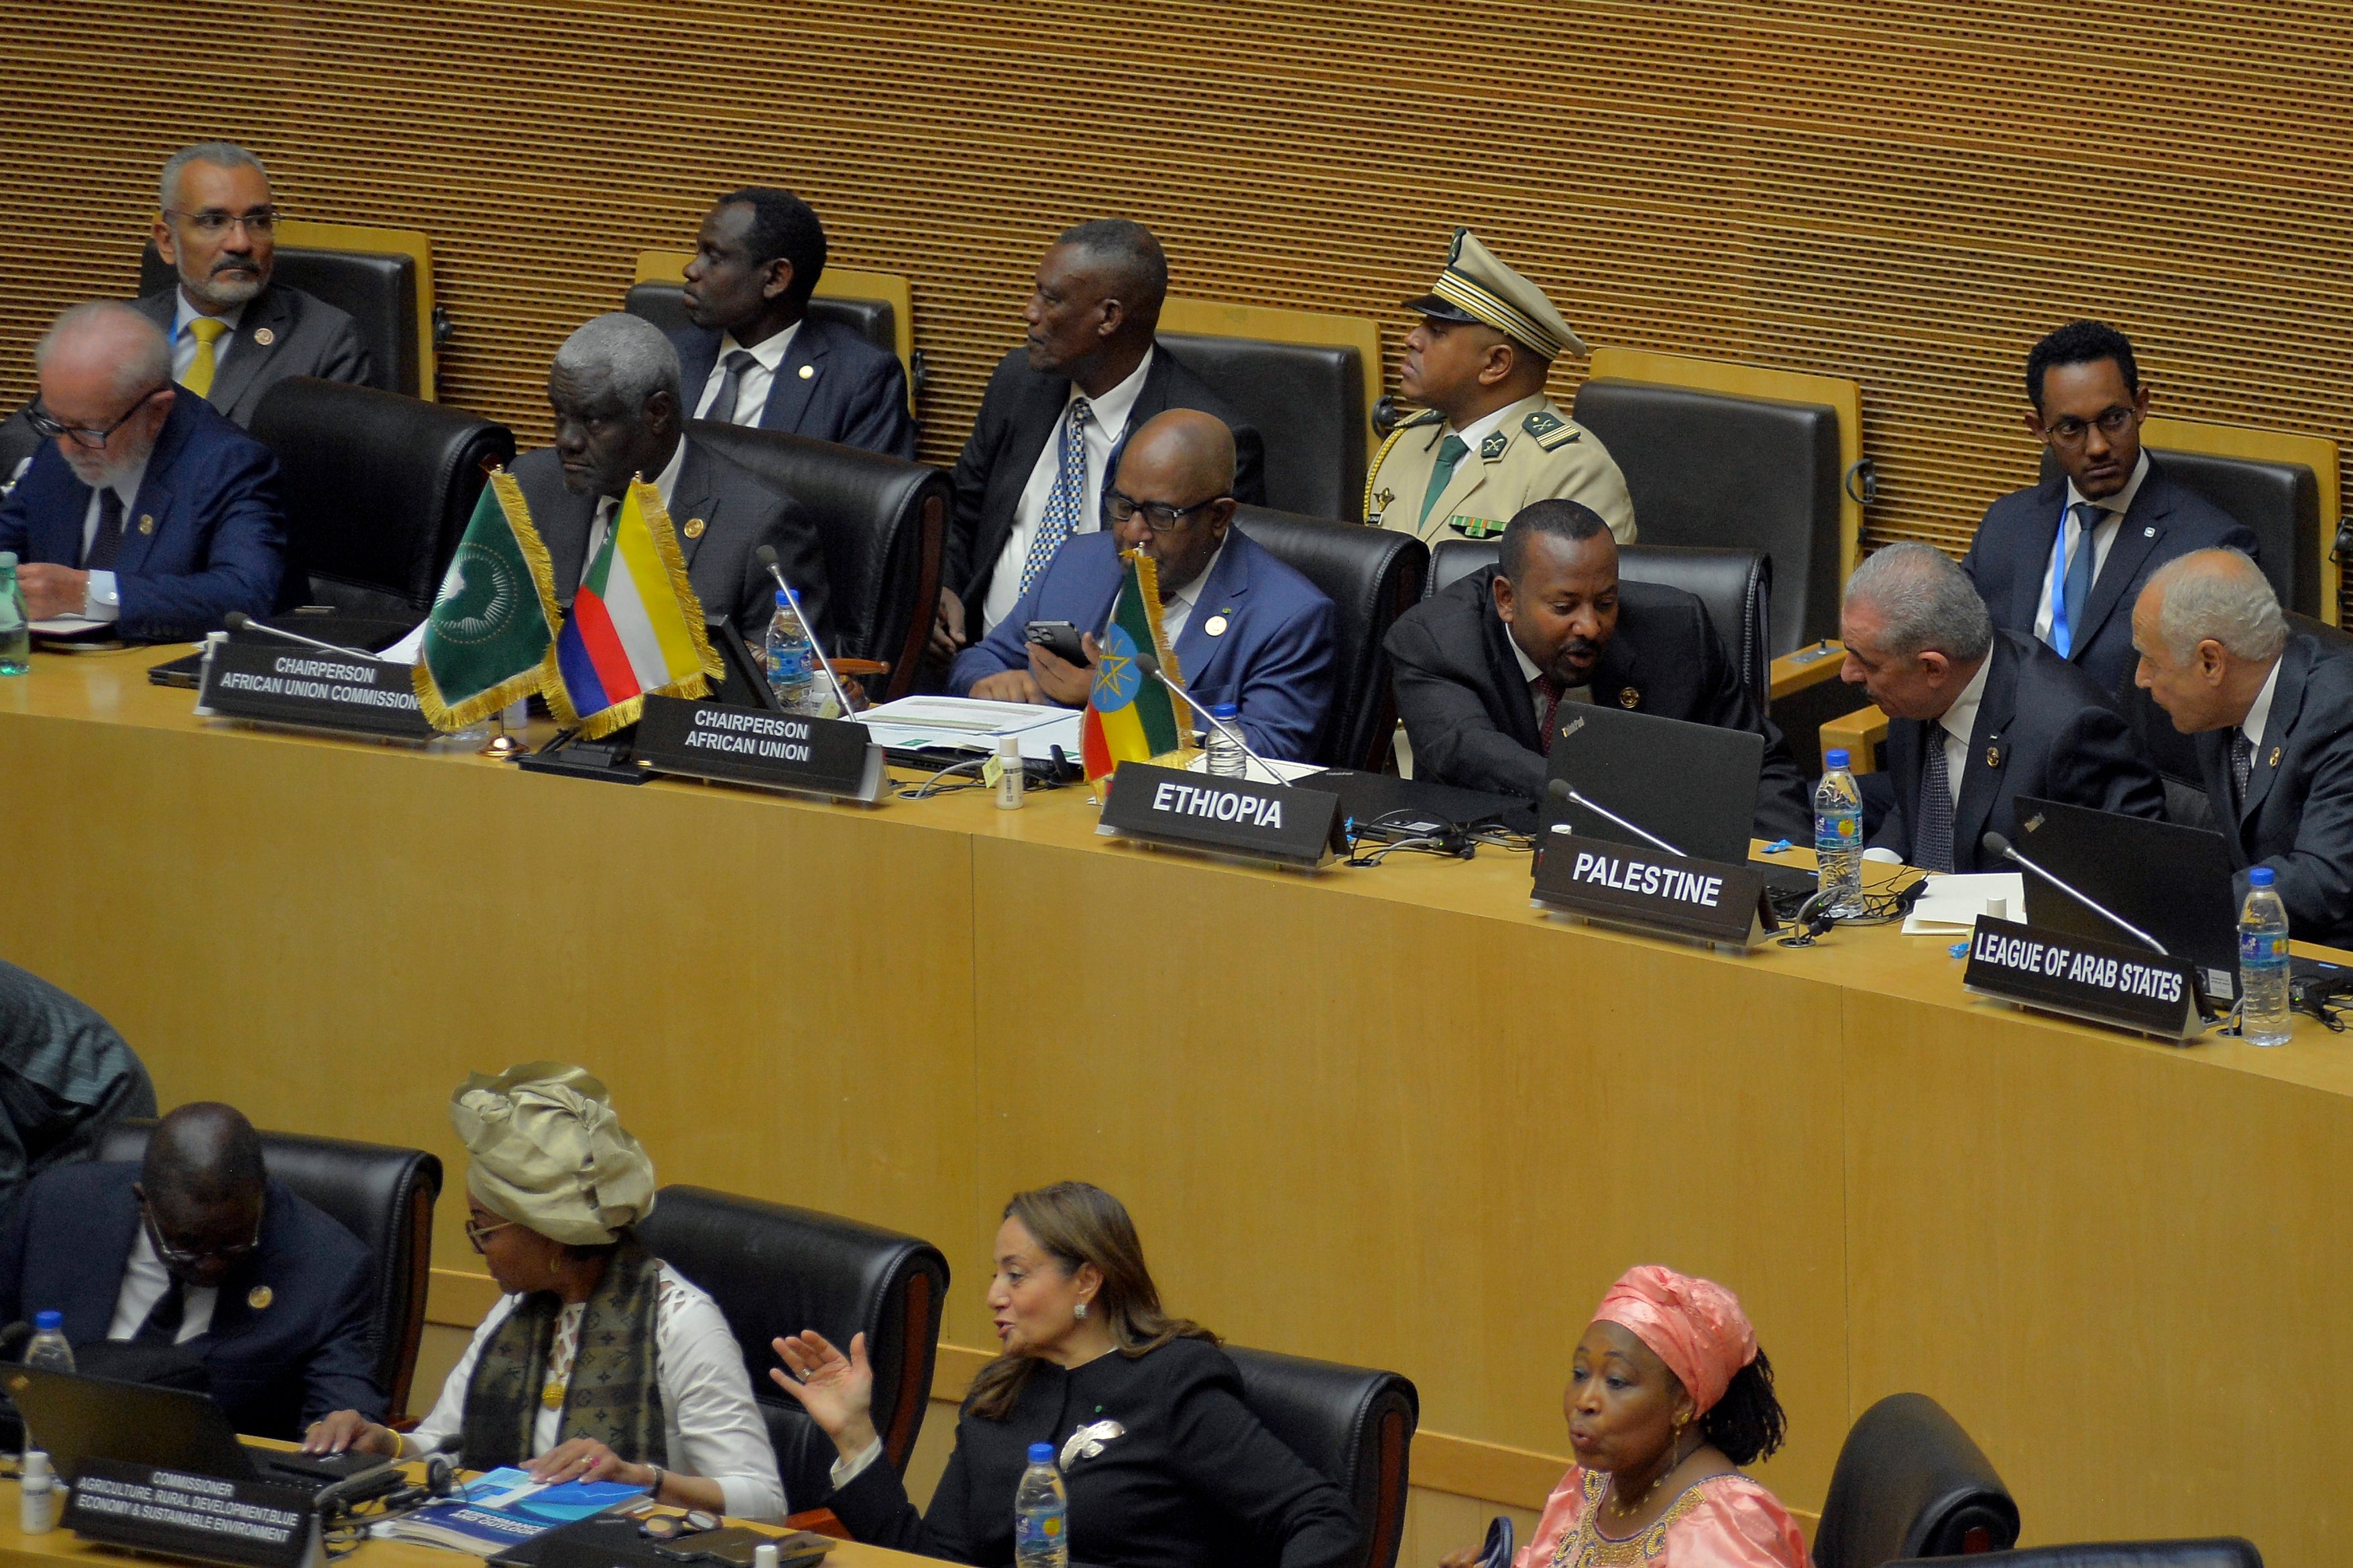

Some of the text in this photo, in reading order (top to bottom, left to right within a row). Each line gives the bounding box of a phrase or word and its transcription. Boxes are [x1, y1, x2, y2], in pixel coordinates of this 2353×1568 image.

[276, 657, 375, 683] CHAIRPERSON
[220, 672, 418, 710] AFRICAN UNION COMMISSION
[695, 709, 809, 739] CHAIRPERSON
[685, 731, 809, 762] AFRICAN UNION
[1153, 782, 1281, 829] ETHIOPIA
[1572, 853, 1723, 907] PALESTINE
[1975, 932, 2044, 972] LEAGUE
[2045, 947, 2070, 977] OF
[2068, 953, 2118, 988] ARAB
[2120, 963, 2183, 1003] STATES
[153, 1471, 234, 1496] COMMISSIONER
[154, 1489, 190, 1507] RURAL
[78, 1494, 290, 1542] ECONOMY & SUSTAINABLE ENVIRONMENT
